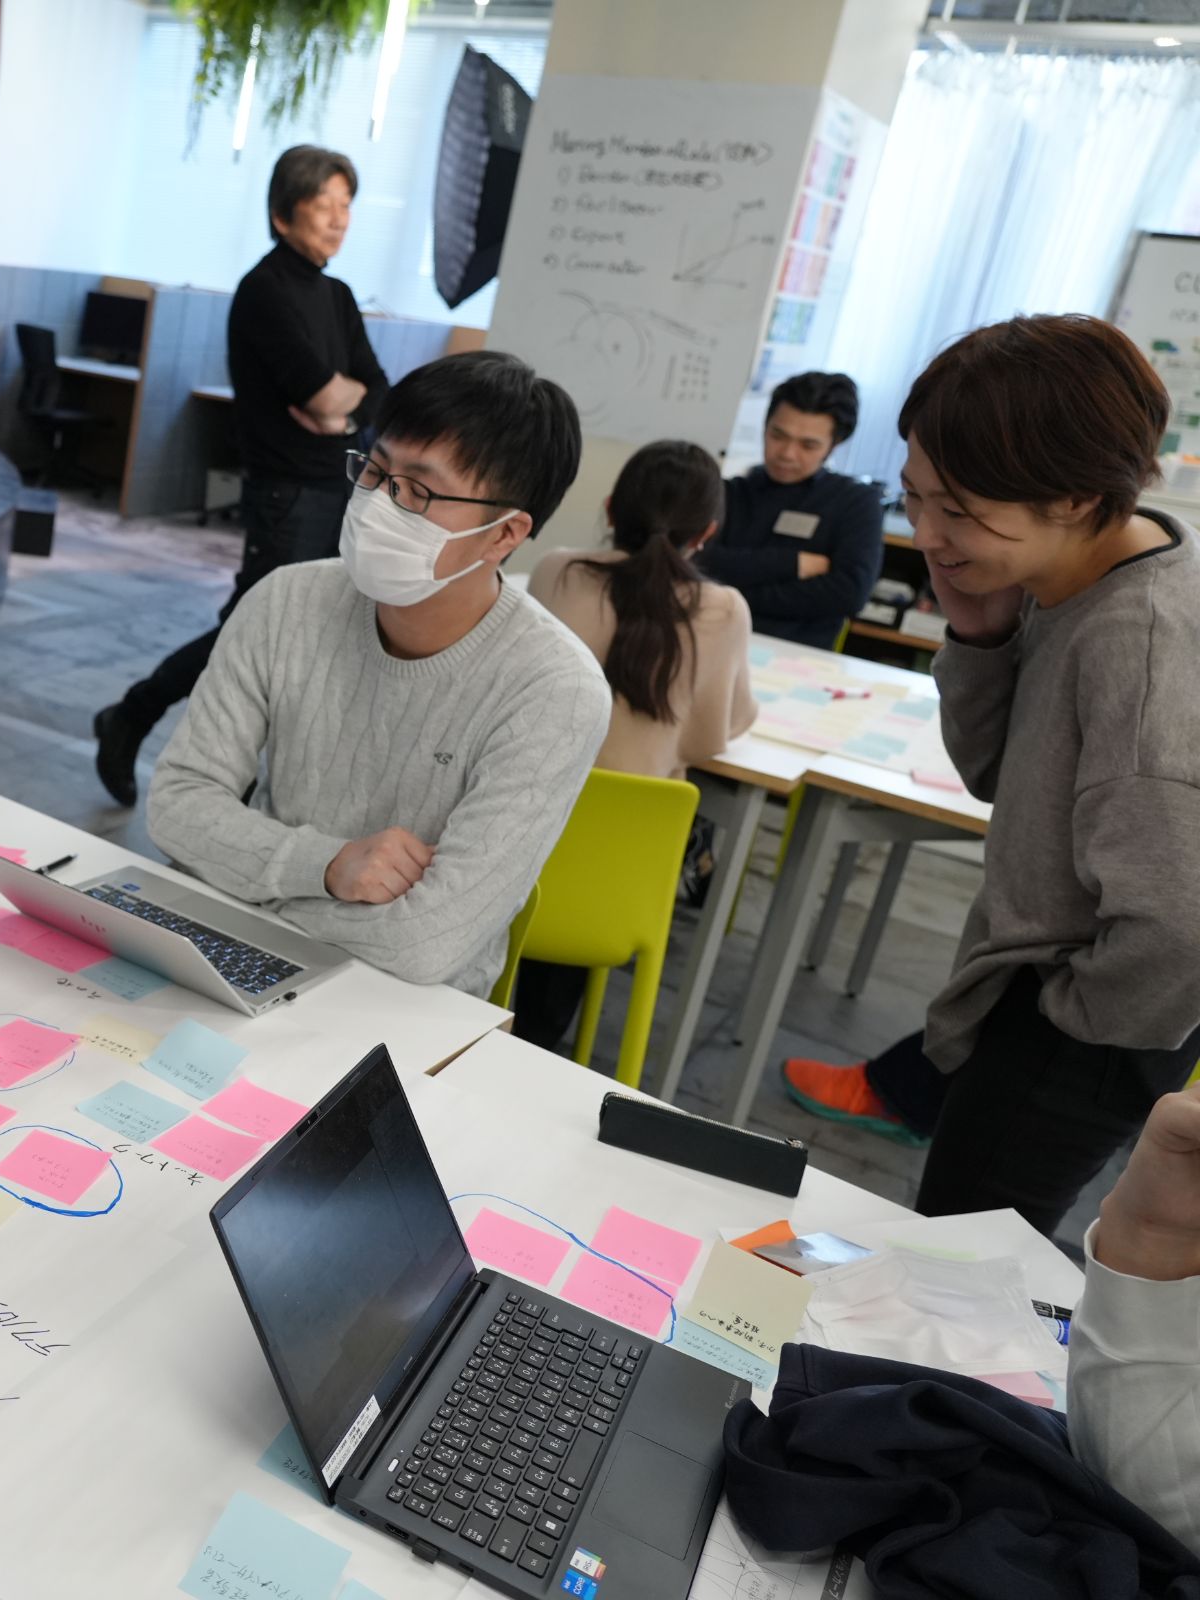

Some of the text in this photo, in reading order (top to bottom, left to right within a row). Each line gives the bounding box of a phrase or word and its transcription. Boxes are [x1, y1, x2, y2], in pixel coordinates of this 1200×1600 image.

[112, 1143, 206, 1187] ネットワーク
